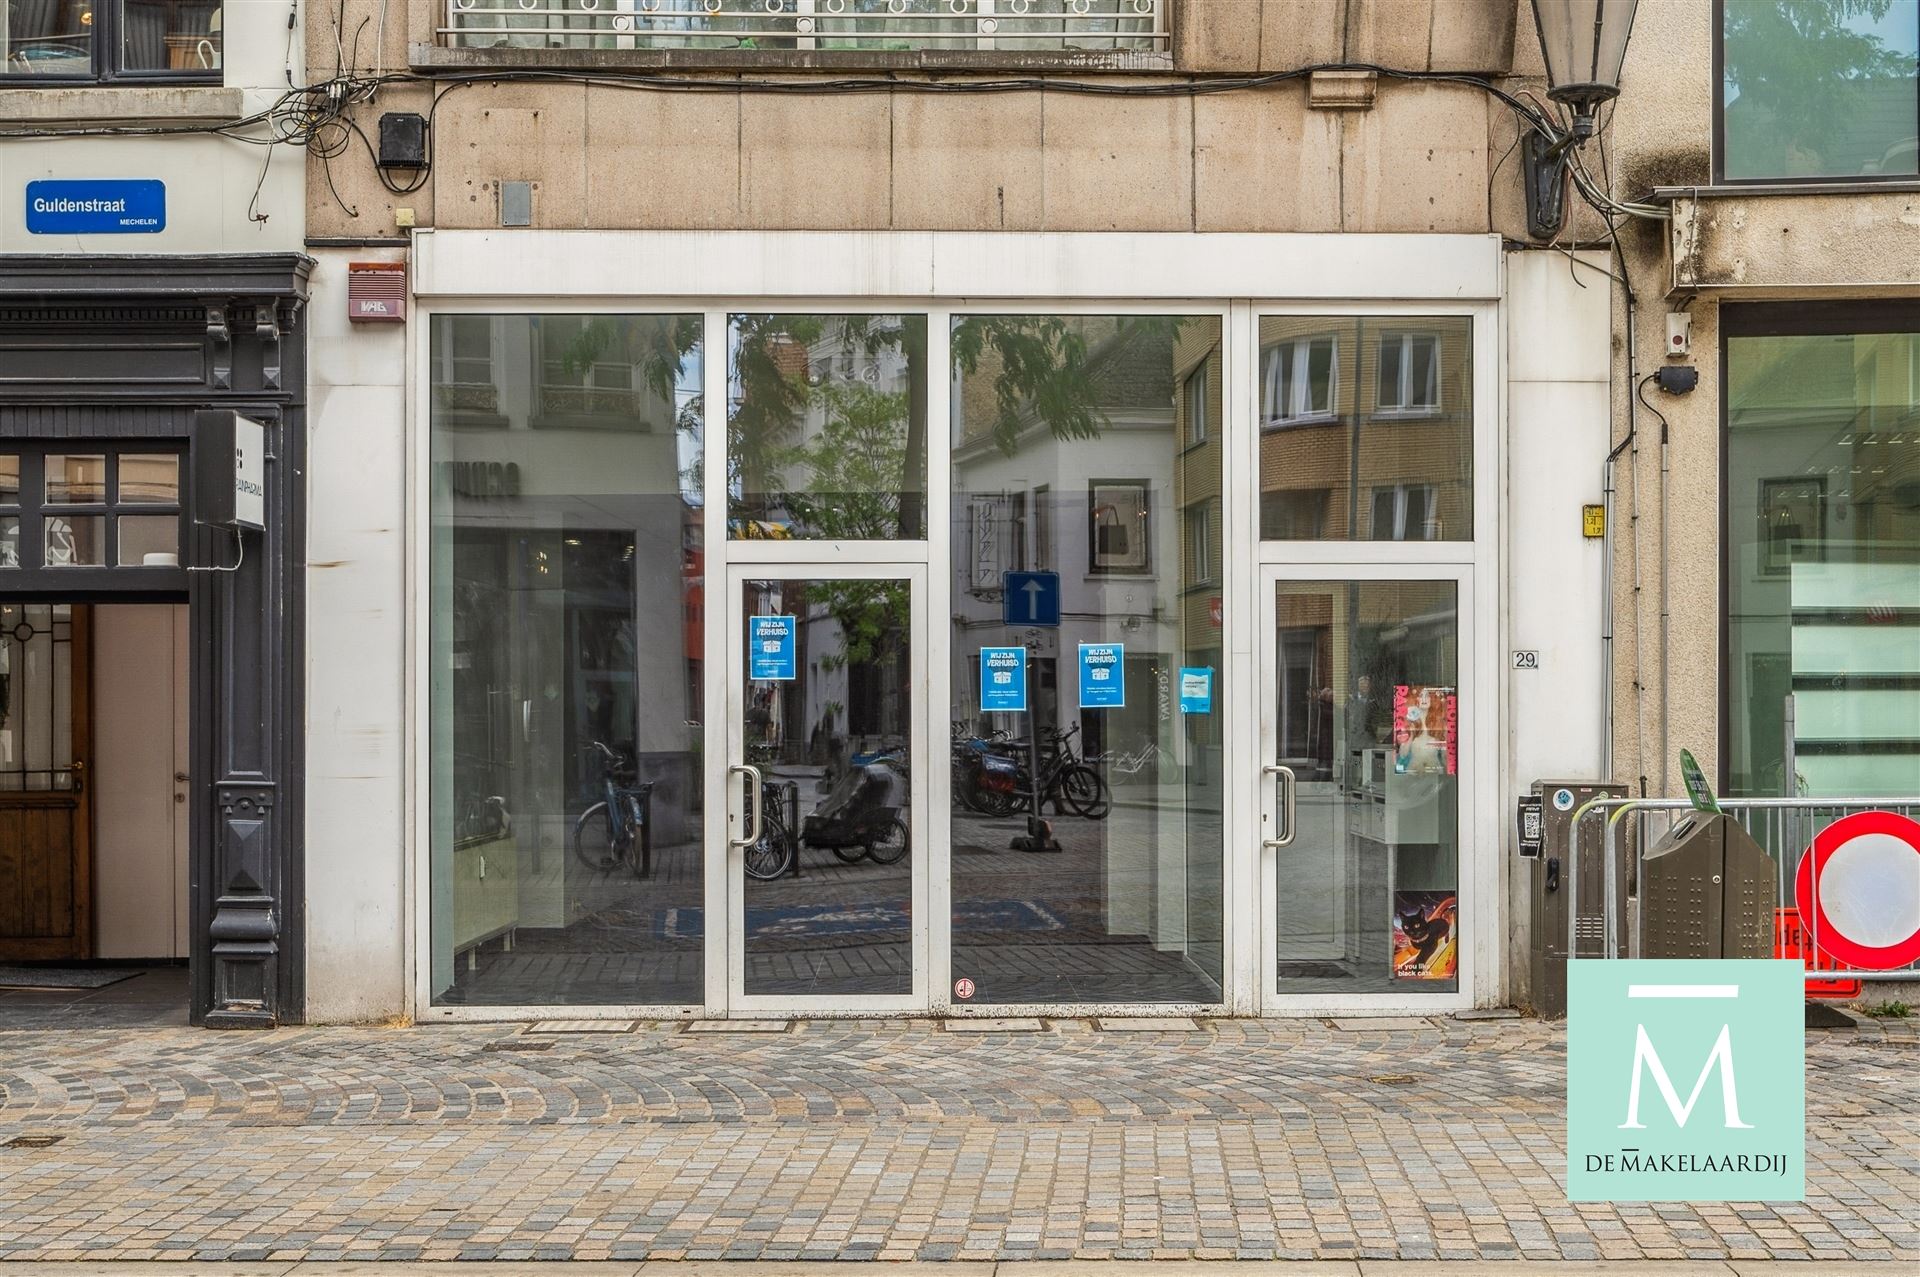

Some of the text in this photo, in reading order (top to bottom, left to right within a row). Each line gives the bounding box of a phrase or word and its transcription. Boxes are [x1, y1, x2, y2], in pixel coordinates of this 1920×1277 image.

[34, 198, 125, 212] Guldenstraat
[756, 628, 789, 636] VERHUISD
[986, 659, 1019, 667] VERHUISD
[1085, 655, 1117, 664] VERHUISD
[1516, 652, 1535, 668] 29
